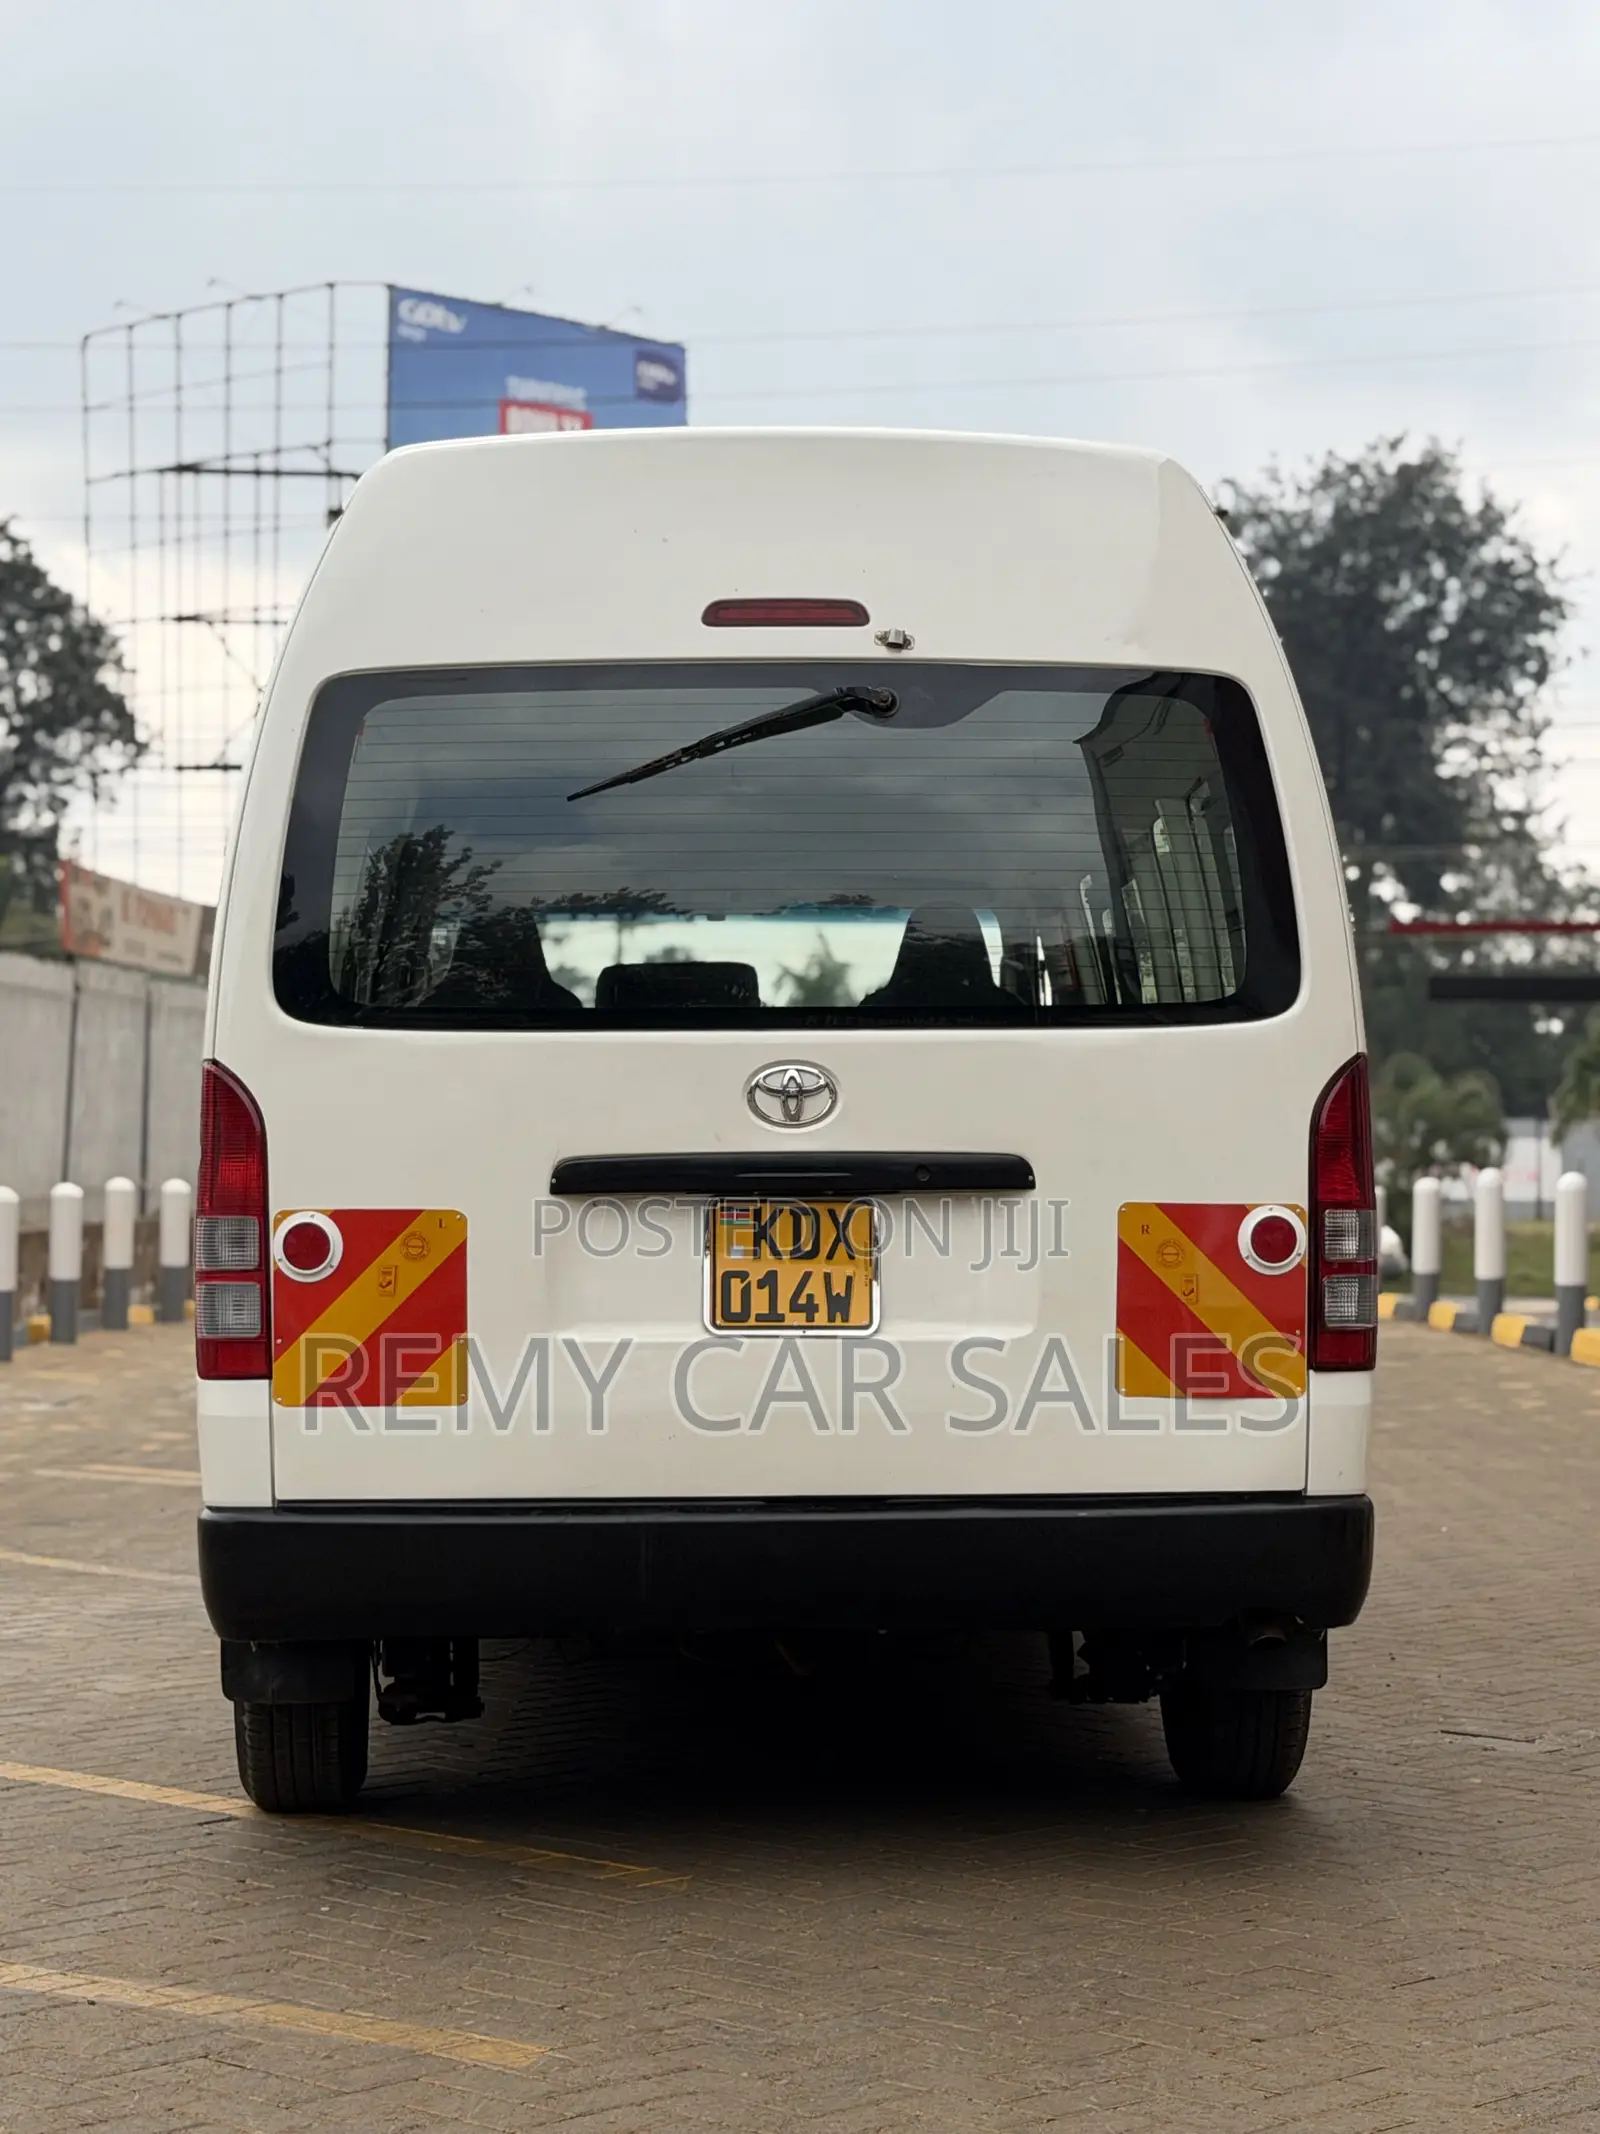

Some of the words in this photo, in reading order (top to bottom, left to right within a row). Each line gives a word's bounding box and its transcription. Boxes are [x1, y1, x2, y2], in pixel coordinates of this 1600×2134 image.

[753, 1207, 855, 1261] KDX
[1141, 1224, 1151, 1235] R
[720, 1269, 854, 1323] 014W
